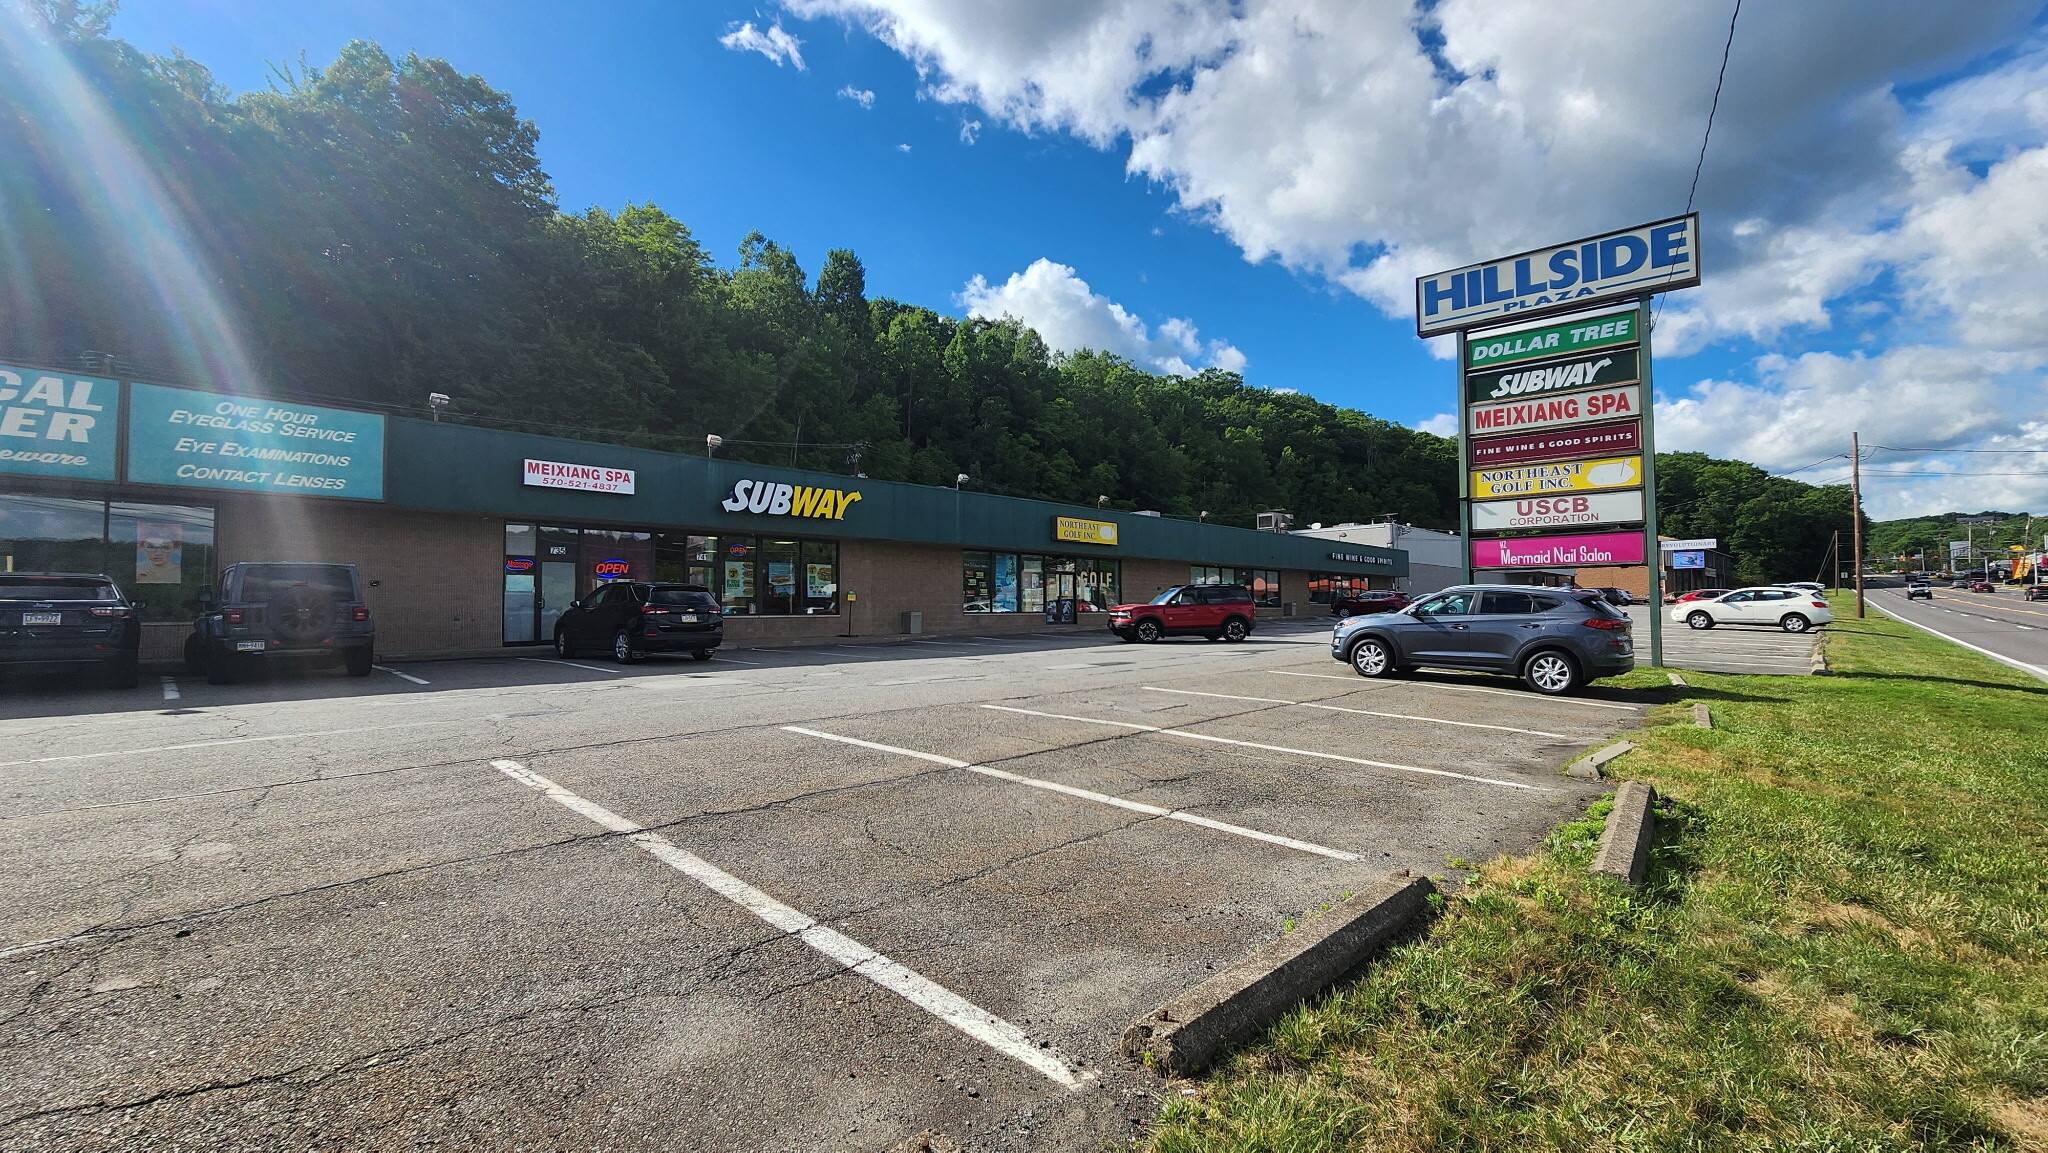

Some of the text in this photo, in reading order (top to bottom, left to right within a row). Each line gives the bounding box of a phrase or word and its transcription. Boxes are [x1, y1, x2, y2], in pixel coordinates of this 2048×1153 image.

[1424, 221, 1690, 317] HILLSIDE
[1503, 286, 1596, 313] PLAZA
[1472, 319, 1630, 361] DOLLAR TREE
[1490, 357, 1612, 398] SUBWAY
[1475, 392, 1631, 430] MEIXIANG SPA
[1476, 446, 1502, 456] FINE
[1505, 443, 1535, 453] WINE
[1548, 438, 1581, 448] GOOD
[1584, 432, 1633, 444] SPIRITS
[527, 461, 631, 484] MEIXIANG SPA
[1481, 463, 1583, 483] NORTHEAST
[542, 477, 618, 491] 570-521-4837
[1491, 477, 1574, 494] GOLF INC.
[722, 479, 863, 520] SUBWAY
[1516, 497, 1590, 517] USCB
[1059, 519, 1099, 531] NORTHEAST
[1509, 512, 1599, 527] CORPORATION
[1063, 530, 1096, 540] GOLF INC.
[730, 546, 748, 555] OPEN
[1332, 552, 1344, 561] FINE
[1345, 553, 1358, 562] WINE
[1500, 545, 1612, 565] Mermaid Nail Salon
[595, 563, 629, 574] OPEN
[1080, 570, 1112, 587] GOLF
